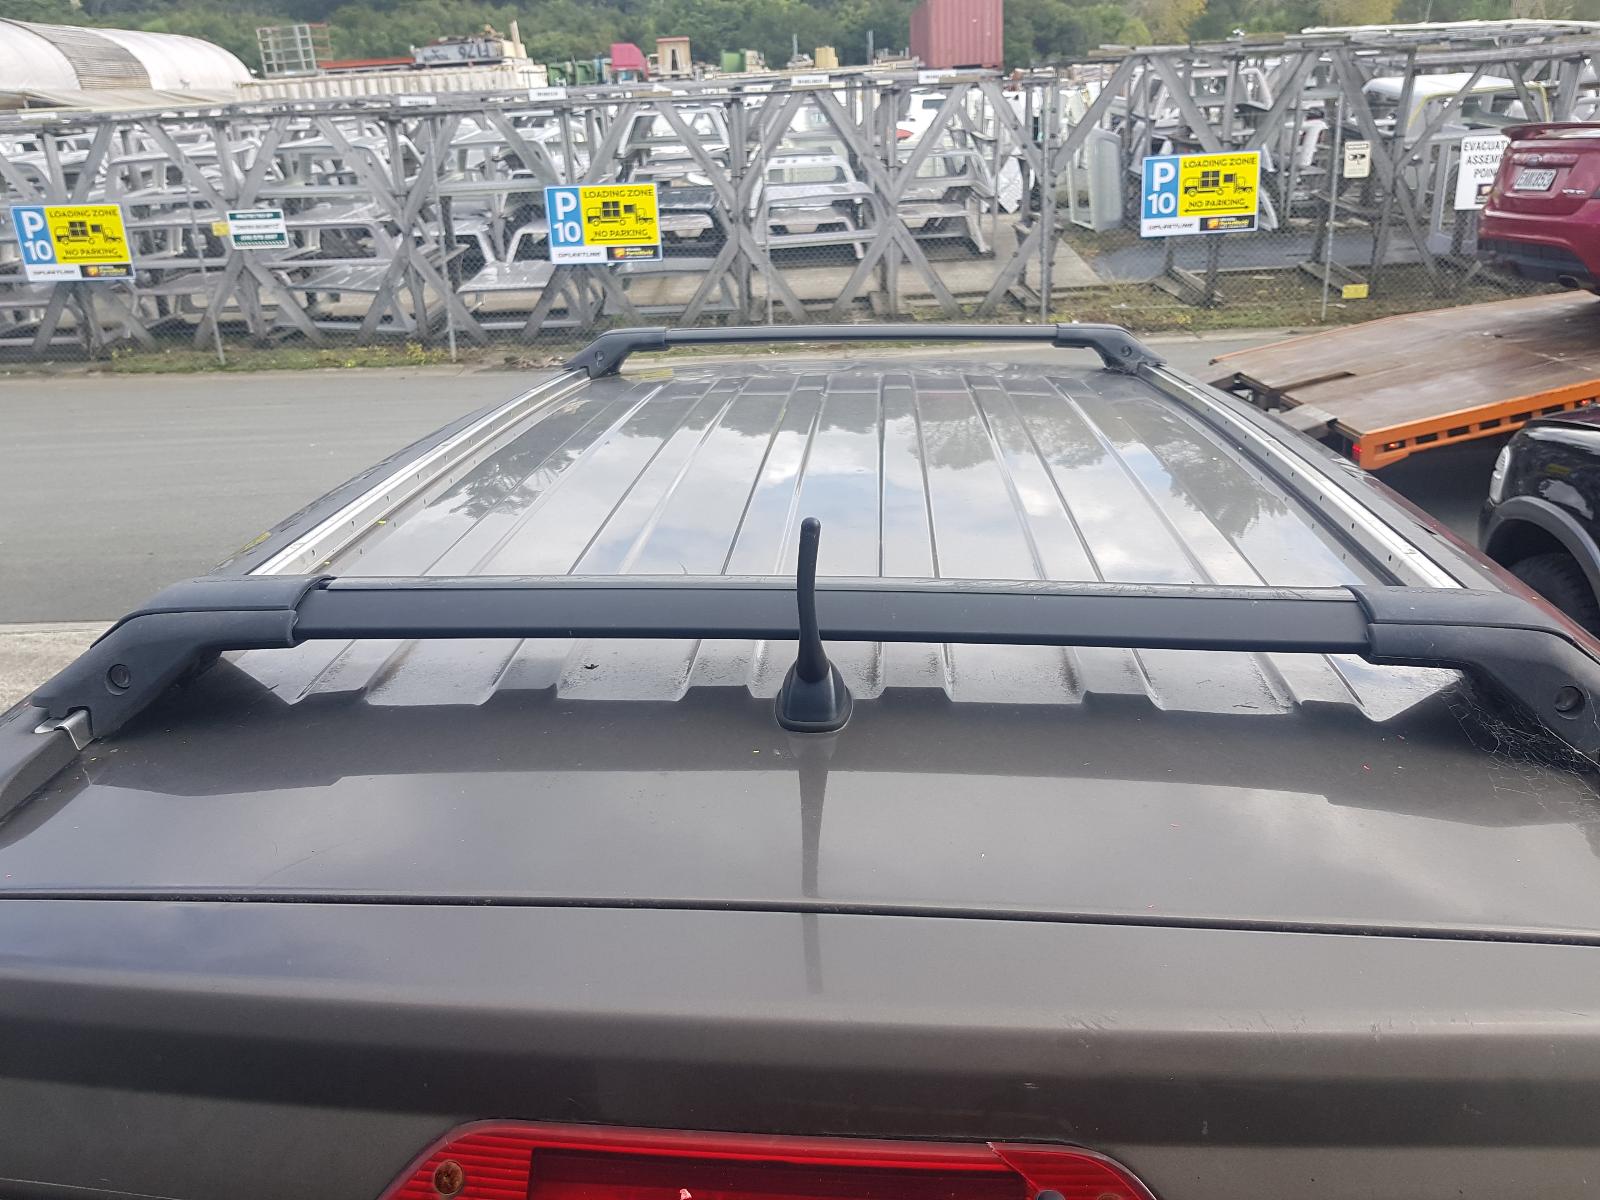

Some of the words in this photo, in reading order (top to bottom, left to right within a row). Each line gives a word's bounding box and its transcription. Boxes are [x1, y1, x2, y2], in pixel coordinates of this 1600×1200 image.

[1183, 160, 1228, 169] LOADING
[1229, 157, 1257, 166] ZONE
[1152, 161, 1176, 192] P
[583, 190, 626, 199] LOADING
[627, 188, 654, 198] ZONE
[554, 191, 578, 221] P
[1147, 191, 1176, 215] 10
[1188, 200, 1203, 208] NO
[1205, 198, 1246, 207] PARKING
[49, 210, 91, 218] LOADING
[92, 209, 119, 217] ZONE
[20, 210, 45, 240] P
[553, 221, 582, 243] 10
[593, 230, 608, 238] NO
[609, 228, 649, 237] PARKING
[24, 239, 54, 261] 10
[64, 248, 79, 256] NO
[80, 247, 119, 256] PARKING
